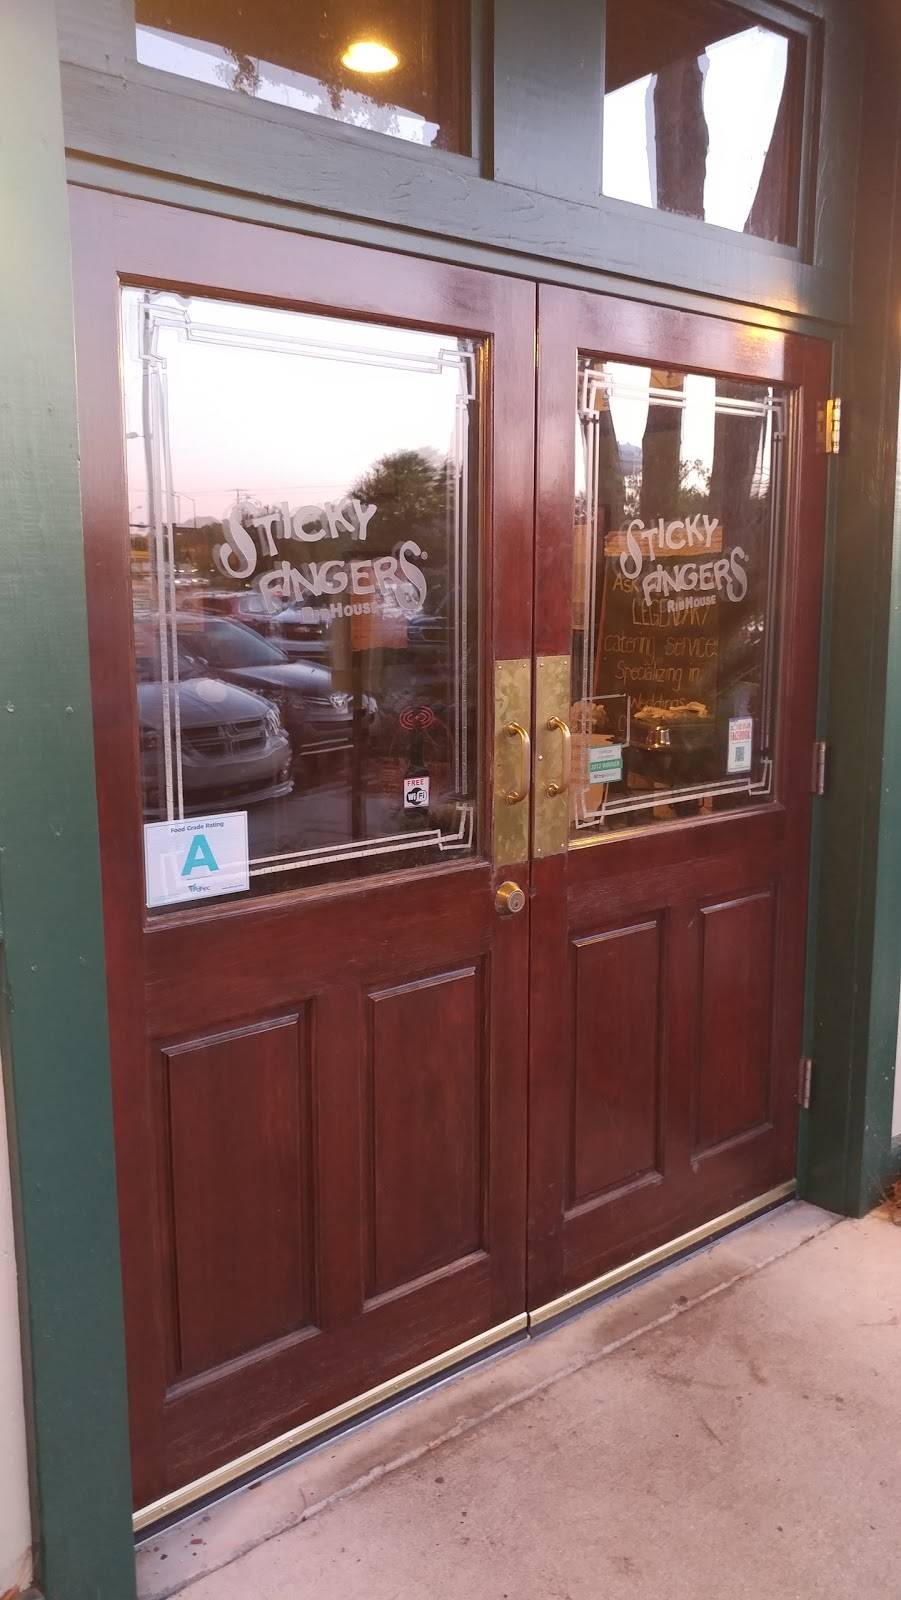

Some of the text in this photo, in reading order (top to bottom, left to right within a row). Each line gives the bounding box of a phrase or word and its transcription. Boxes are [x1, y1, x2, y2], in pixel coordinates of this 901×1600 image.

[407, 779, 424, 787] FREE
[170, 821, 224, 834] Food Grade Rating
[181, 834, 219, 876] A
